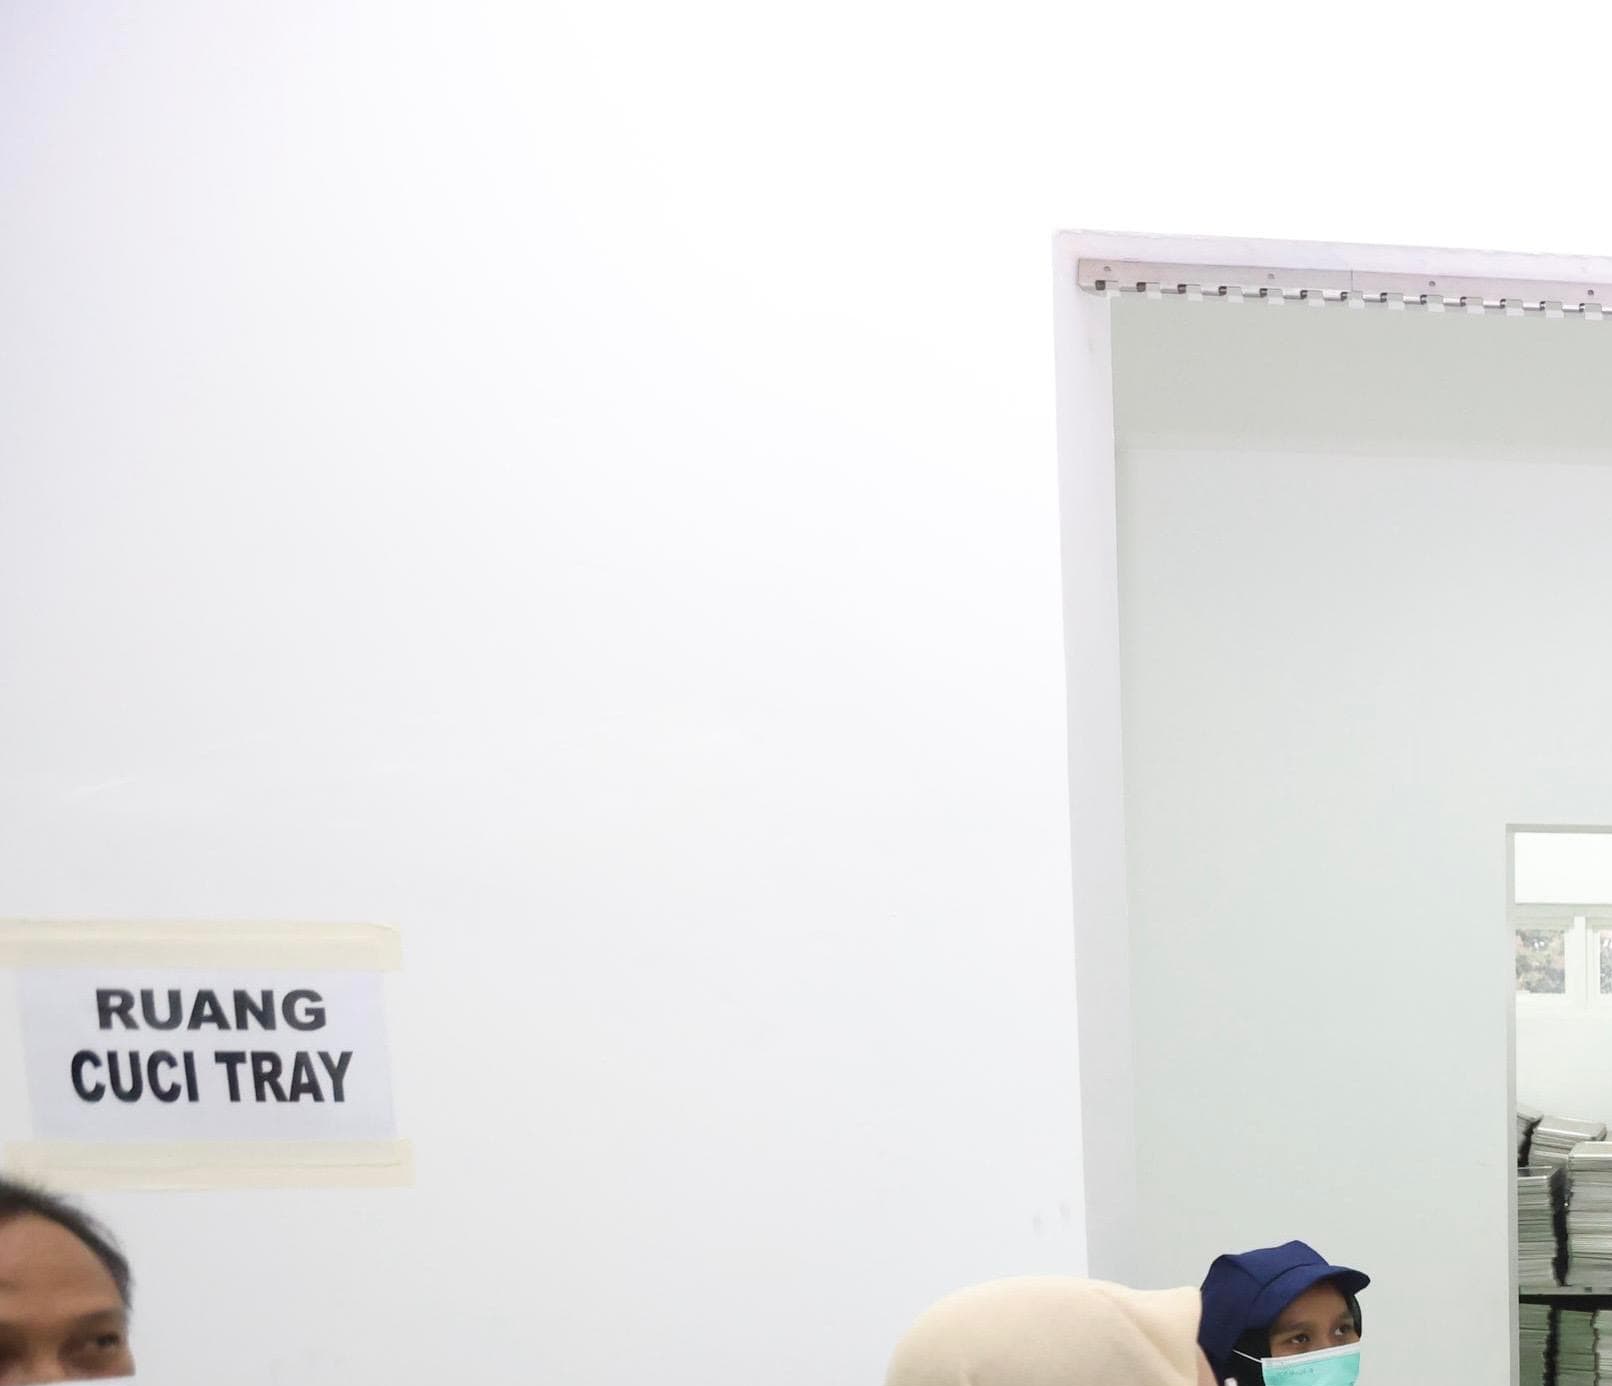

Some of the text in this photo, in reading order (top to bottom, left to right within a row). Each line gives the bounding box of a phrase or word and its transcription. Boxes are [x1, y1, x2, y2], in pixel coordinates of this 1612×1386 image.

[95, 988, 326, 1031] RUANG
[70, 1049, 353, 1103] CUCI TRAY
